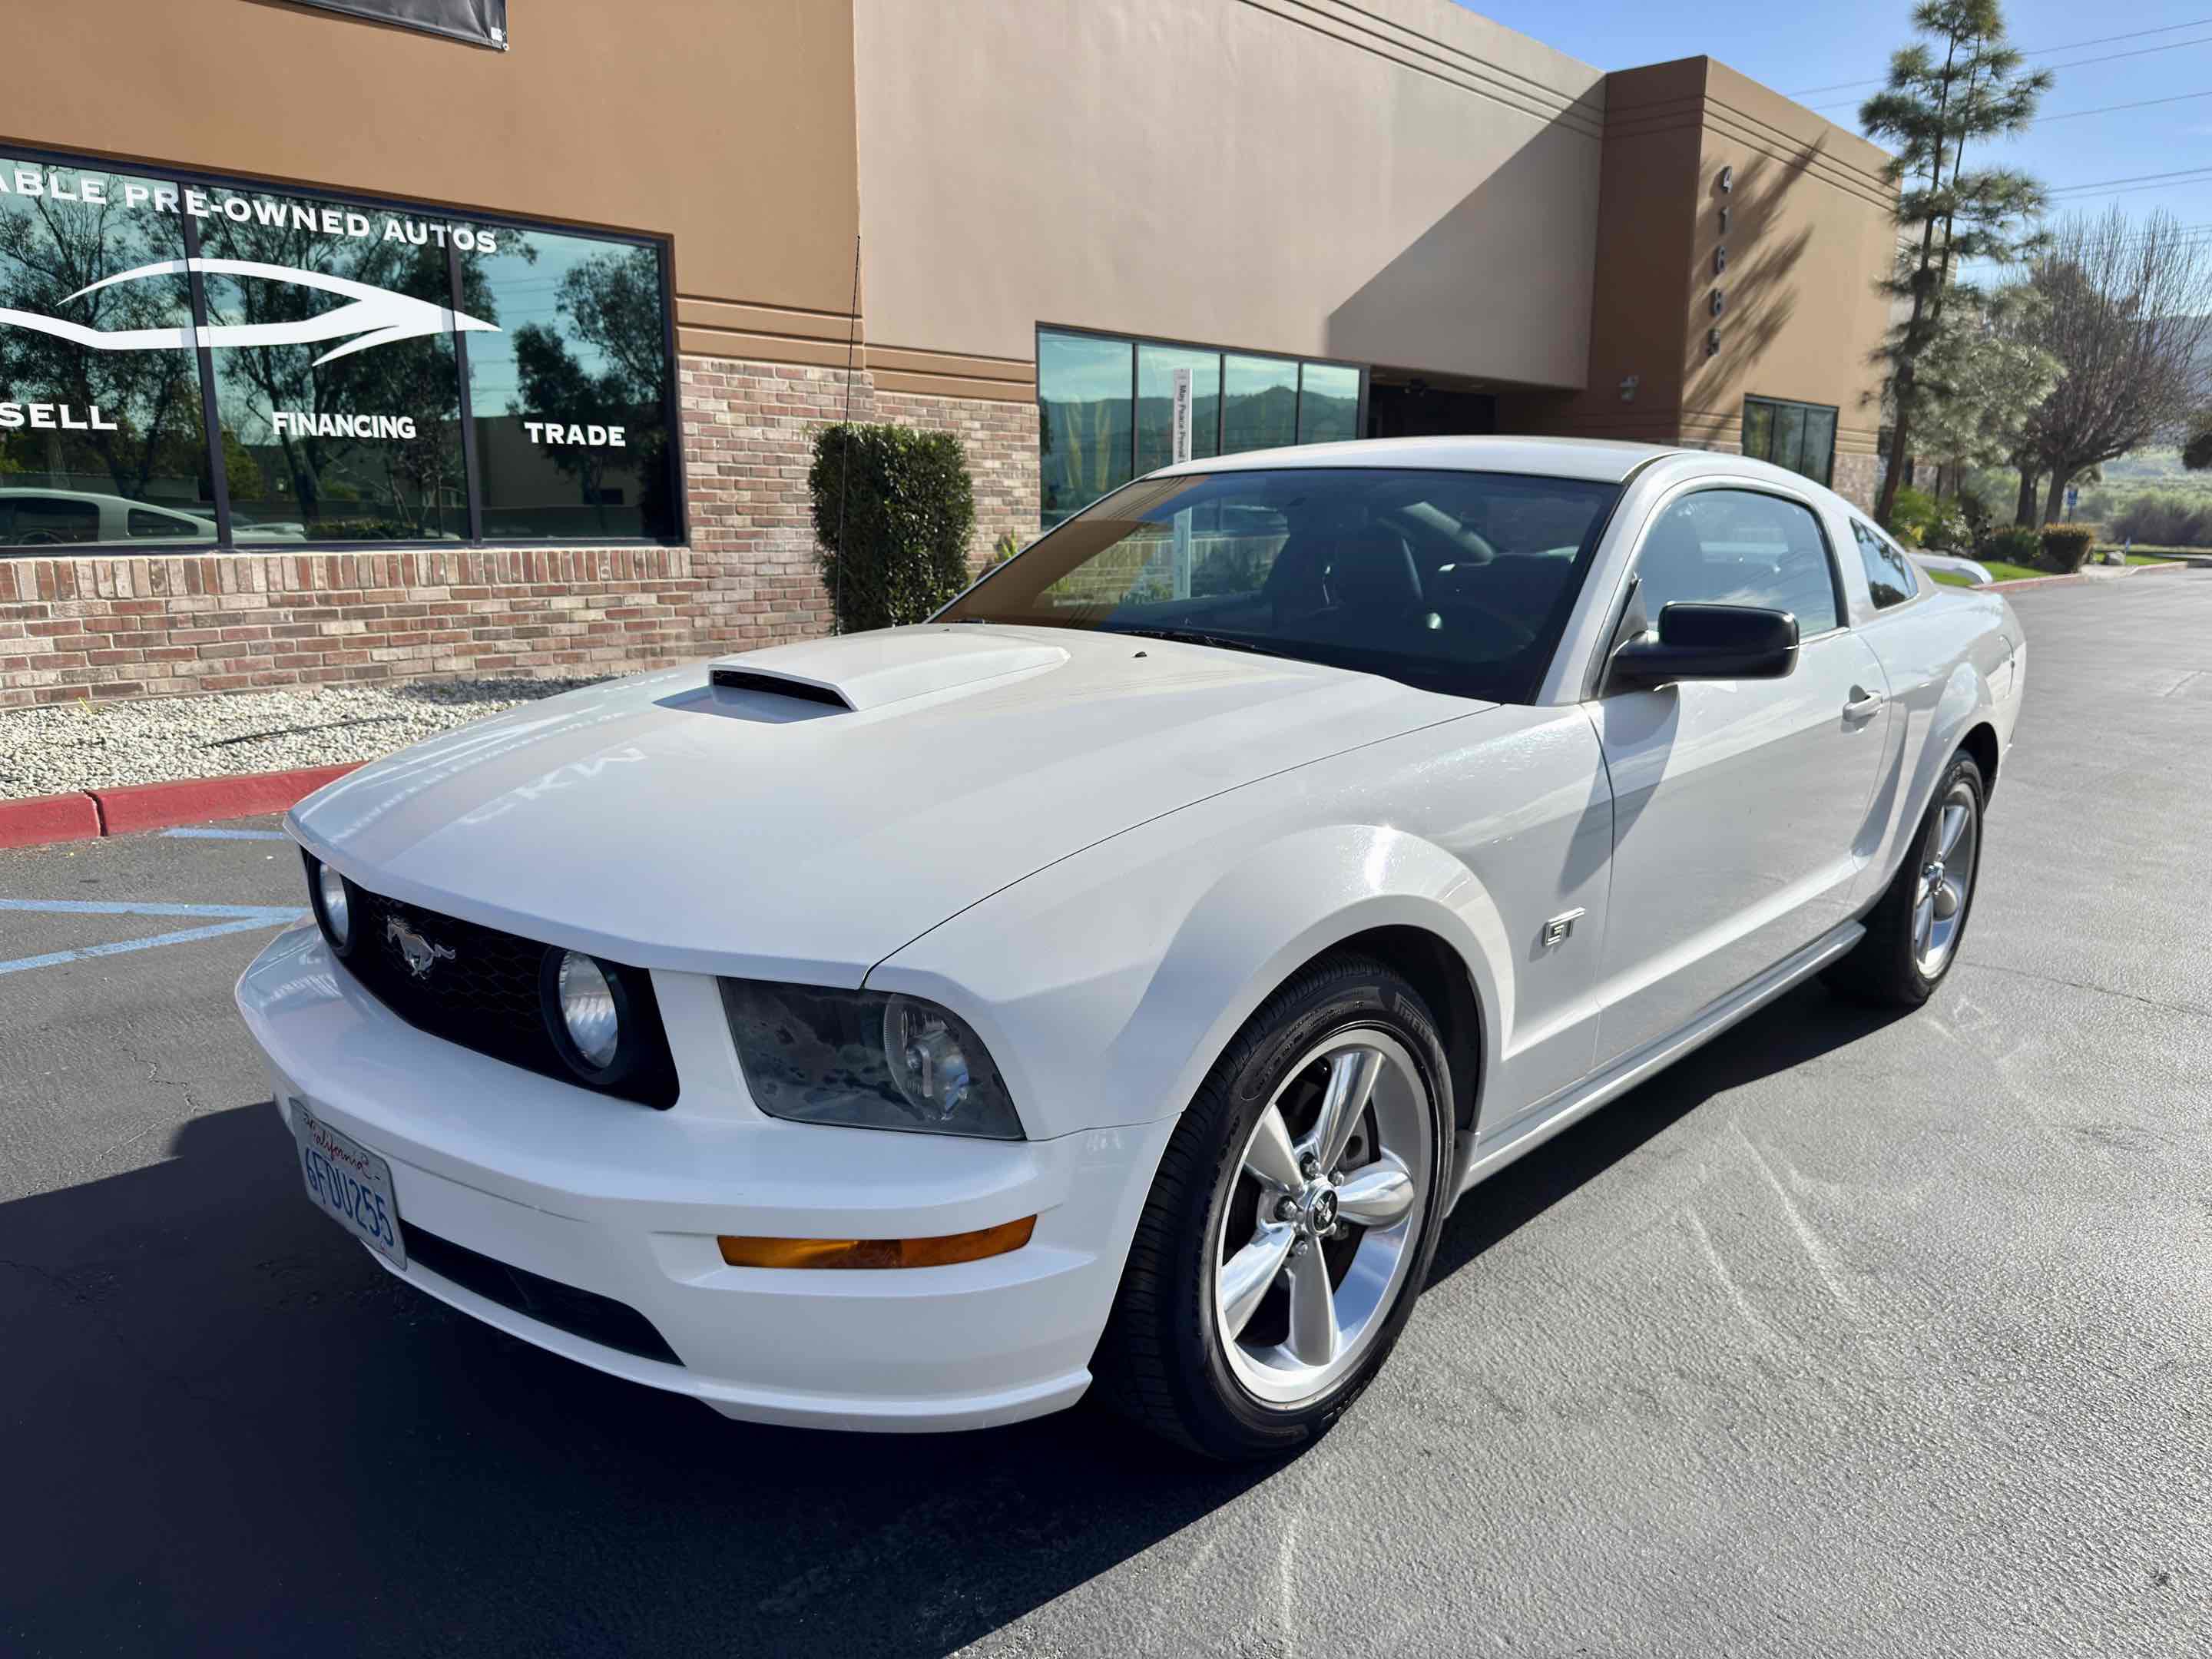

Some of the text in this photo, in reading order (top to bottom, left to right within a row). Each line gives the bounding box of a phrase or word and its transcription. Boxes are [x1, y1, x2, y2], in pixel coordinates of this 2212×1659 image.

[124, 182, 370, 237] PRE-OWNED
[382, 219, 497, 253] AUTOS
[0, 402, 118, 430] SELL
[272, 412, 416, 439] FINANCING
[524, 422, 626, 447] TRADE
[1541, 906, 1586, 946] GT
[306, 1147, 394, 1247] 6FDU255
